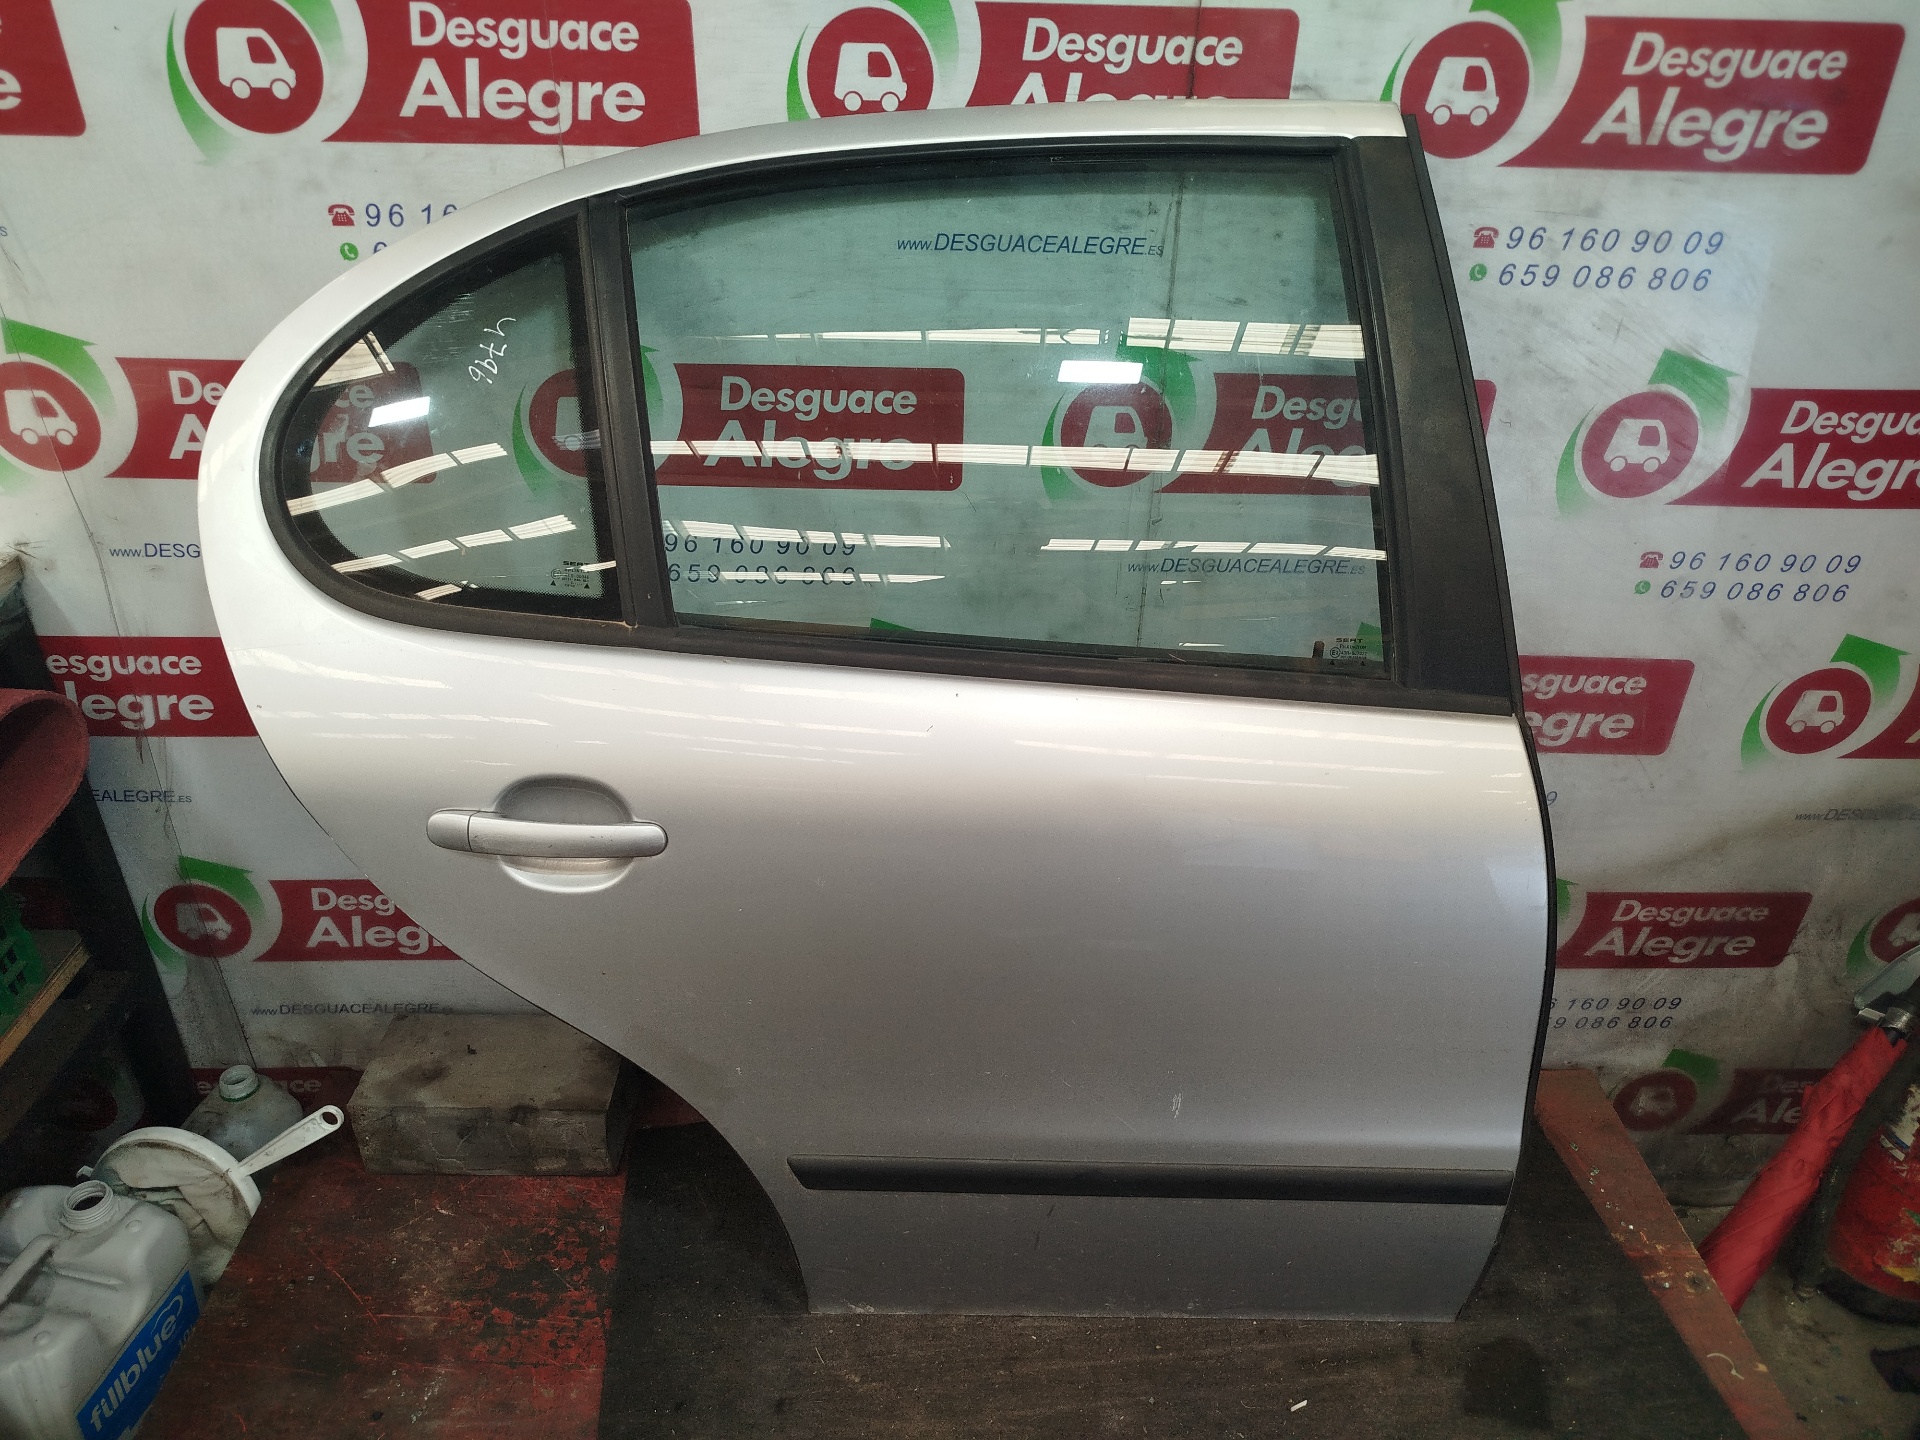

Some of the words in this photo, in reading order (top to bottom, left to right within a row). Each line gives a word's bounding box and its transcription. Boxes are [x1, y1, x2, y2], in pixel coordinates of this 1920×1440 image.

[410, 1, 640, 60] Desguace
[1022, 17, 1243, 74] Desguace
[1621, 32, 1848, 88] Desguace
[399, 58, 646, 134] Alegre
[1581, 86, 1829, 163] Alegre
[365, 203, 405, 228] 96
[896, 232, 1165, 256] www.DESGUACEALEGRE.ES
[1505, 226, 1547, 251] 96
[1560, 227, 1620, 253] 160
[1631, 229, 1673, 254] 90
[1684, 231, 1725, 256] 09
[1498, 263, 1561, 288] 659
[1573, 265, 1635, 290] 086
[1648, 267, 1712, 292] 806
[720, 375, 918, 422] Desguace
[1780, 400, 1920, 444] Desgua
[1741, 442, 1920, 502] Alegr
[109, 542, 201, 559] www.DESG
[664, 533, 698, 553] 96
[668, 563, 721, 584] 659
[1127, 557, 1366, 576] www.DESGUACEALEGRE.ES
[1668, 551, 1707, 571] 96
[1718, 552, 1772, 573] 160
[1780, 554, 1817, 574] 90
[1825, 555, 1863, 575] 09
[1660, 580, 1717, 600] 659
[1727, 582, 1785, 602] 086
[1793, 583, 1850, 603] 806
[46, 654, 203, 682] esguace
[1522, 673, 1647, 700] sguace
[63, 680, 215, 730] legre
[1524, 711, 1635, 747] egre
[310, 887, 396, 916] Desg
[1611, 899, 1770, 928] Desguace
[305, 915, 443, 956] Aleg
[1583, 926, 1757, 964] Alegre
[1567, 997, 1610, 1011] 160
[1617, 997, 1646, 1011] 90
[1653, 997, 1682, 1011] 09
[1574, 1016, 1620, 1029] 086
[1627, 1016, 1674, 1029] 806
[90, 1314, 177, 1433] fillblue
